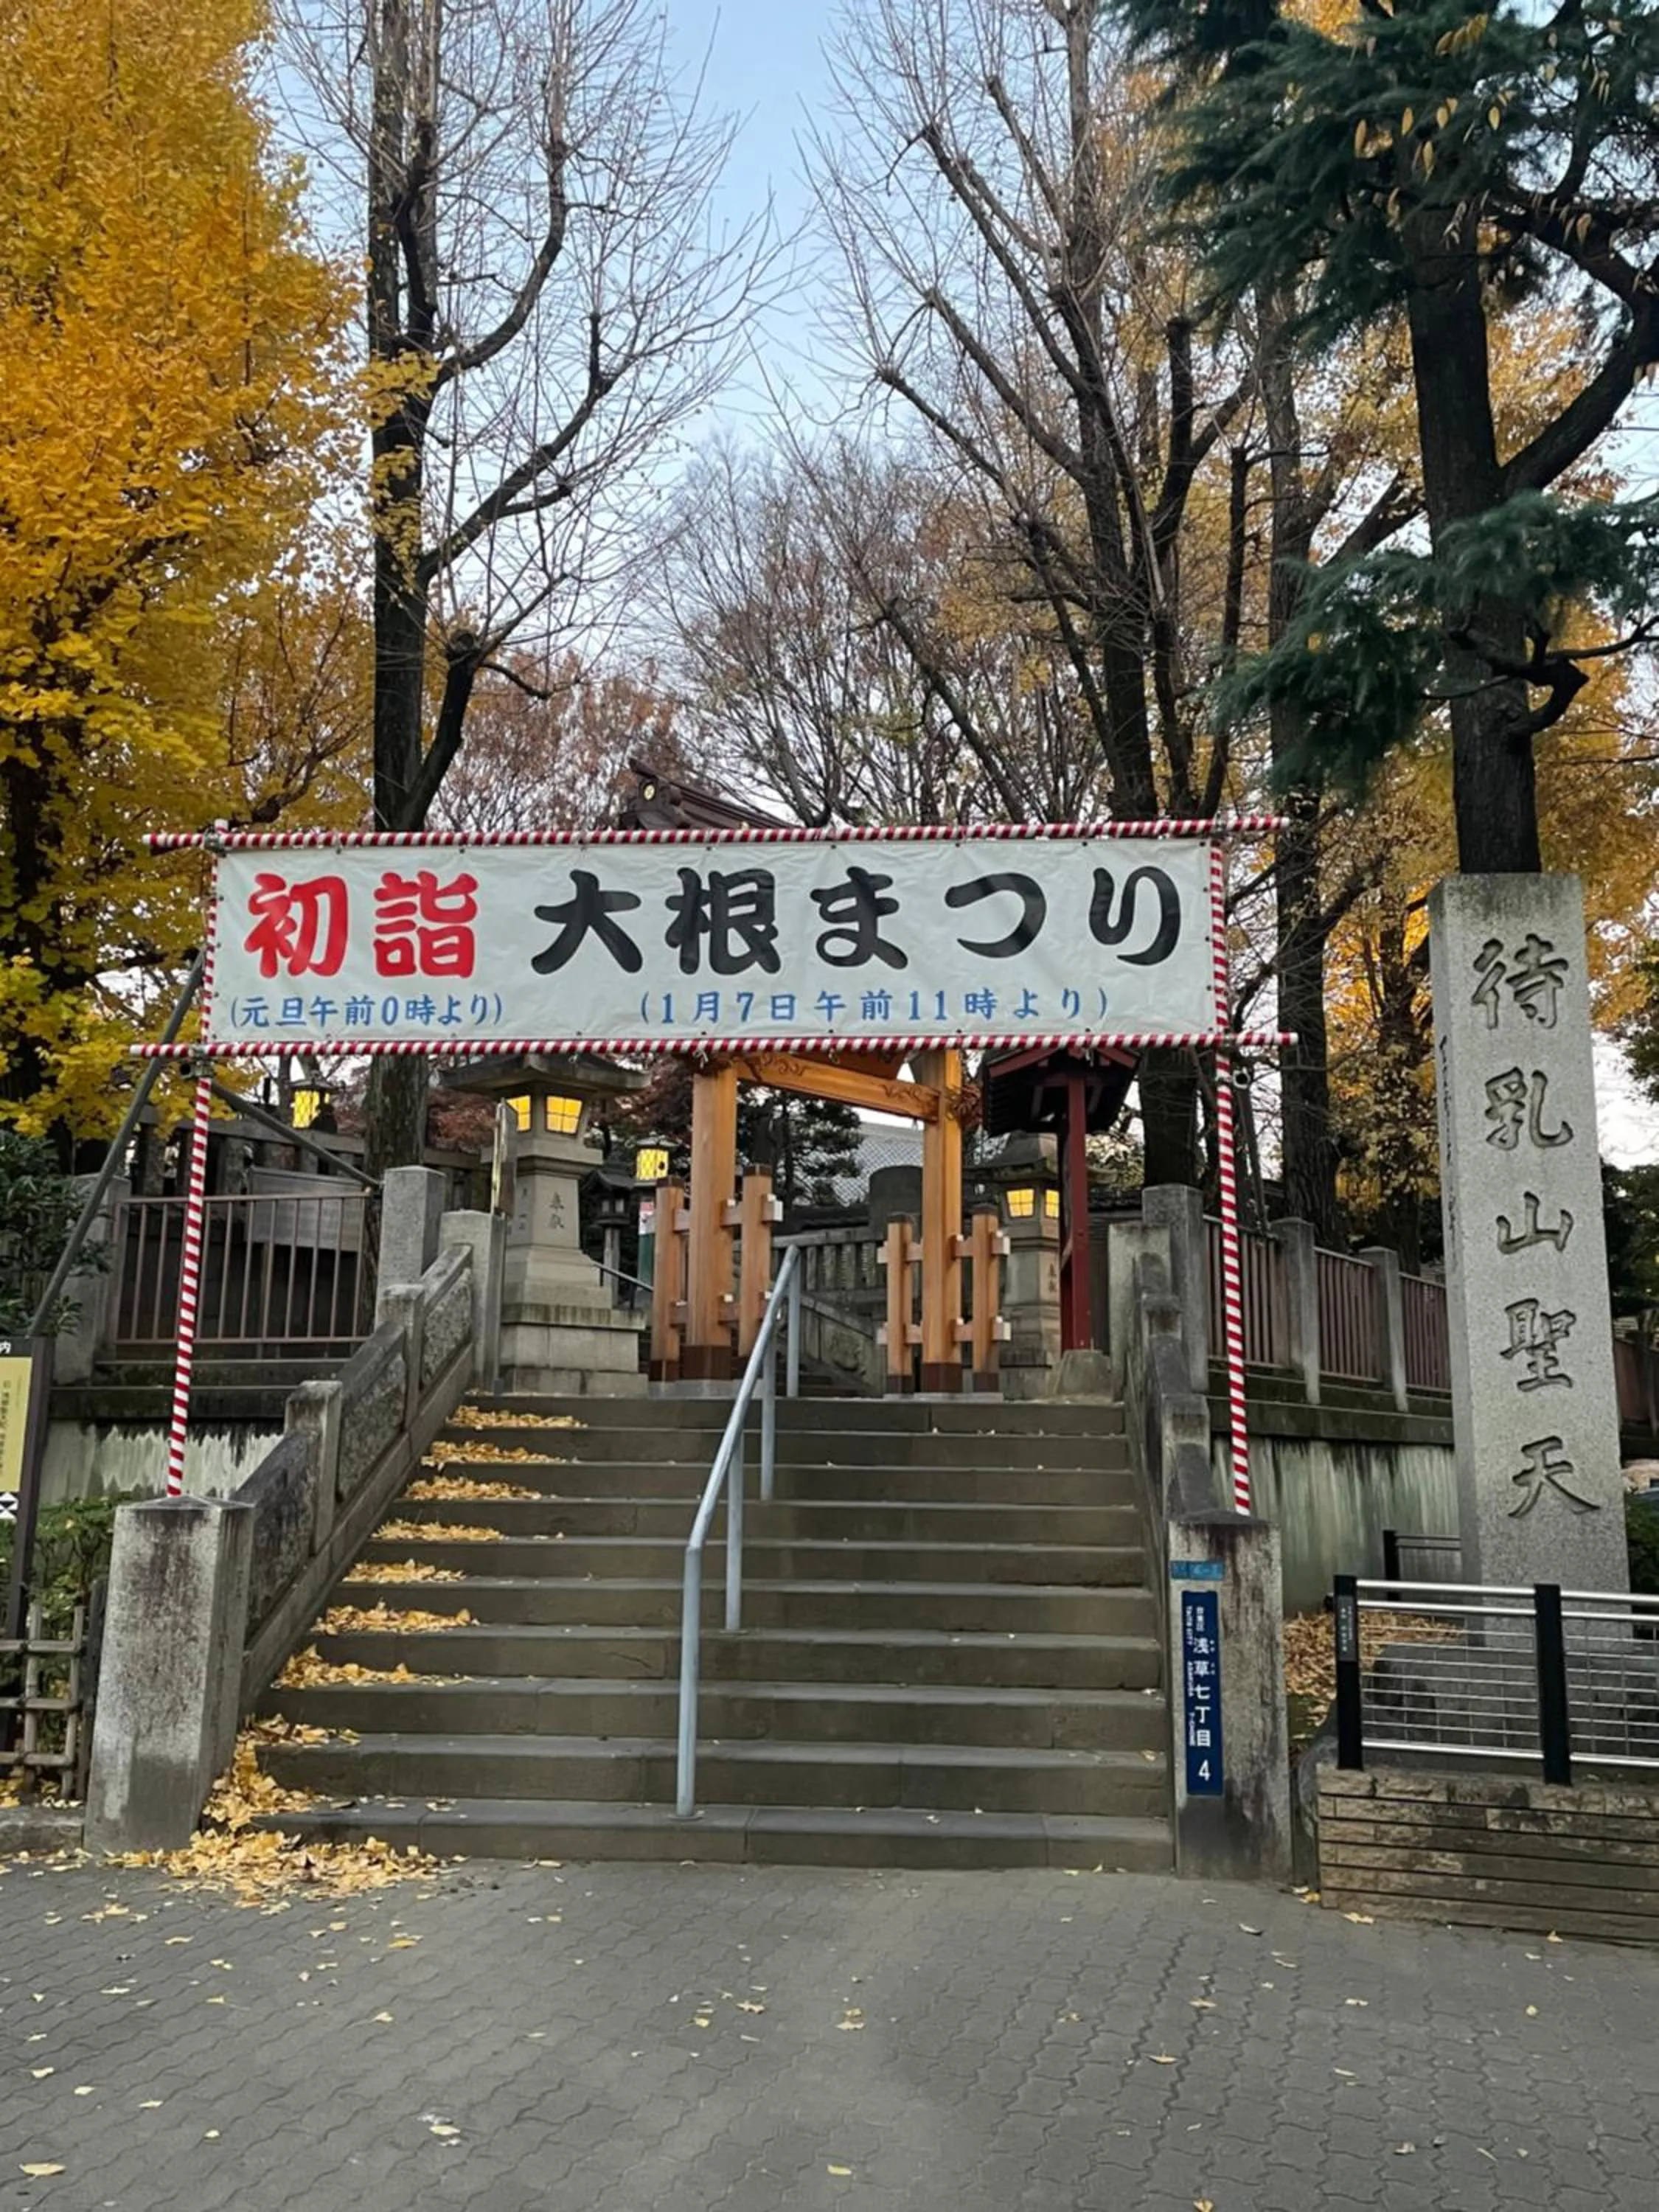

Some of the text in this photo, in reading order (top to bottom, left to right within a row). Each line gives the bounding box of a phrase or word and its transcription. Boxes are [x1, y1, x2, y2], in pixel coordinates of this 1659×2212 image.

[244, 866, 1182, 978] 初詣 大根まつり
[230, 992, 503, 1028] (元旦午前0時より)
[1472, 932, 1601, 1523] 待乳山聖天
[1193, 1638, 1211, 1747] 浅草七丁目
[1198, 1759, 1211, 1781] 4
